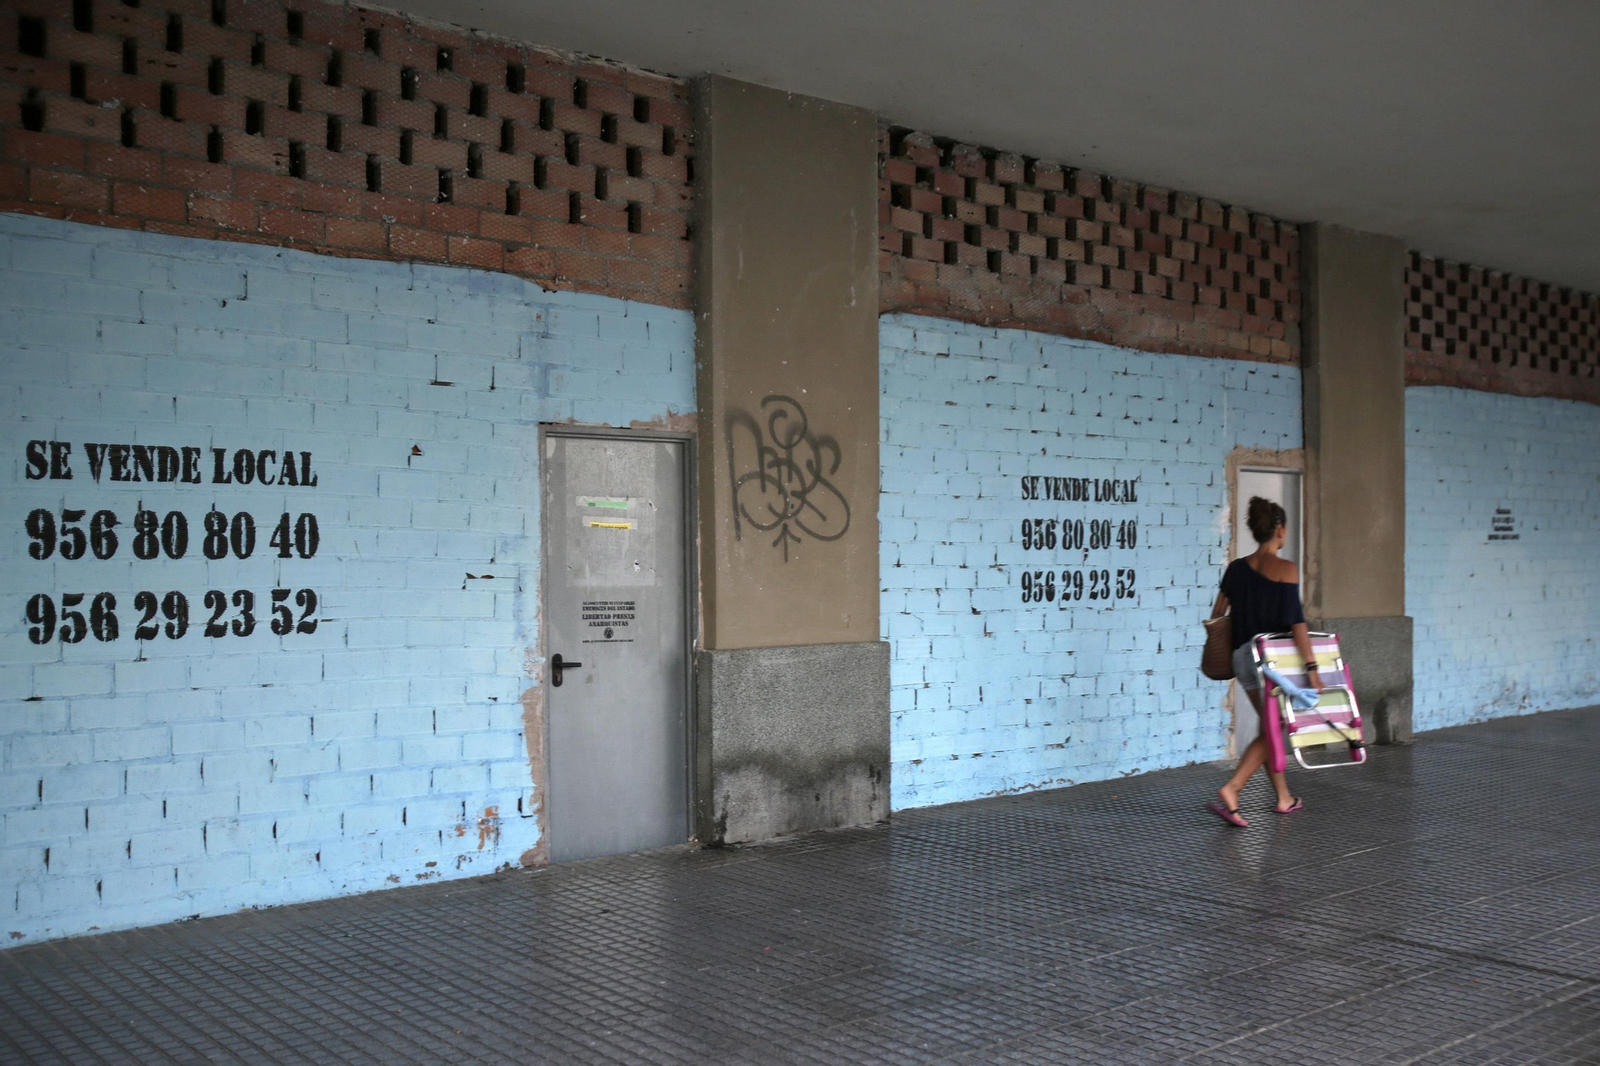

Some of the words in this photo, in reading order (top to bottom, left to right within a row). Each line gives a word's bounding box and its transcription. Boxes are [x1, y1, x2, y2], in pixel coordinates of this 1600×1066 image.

[25, 440, 73, 480] SE
[84, 443, 201, 484] VENDE
[212, 448, 318, 486] LOCAL
[1021, 476, 1040, 500] SE
[1043, 476, 1090, 501] VENDE
[1094, 478, 1138, 502] LOCAL
[25, 508, 118, 560] 956
[132, 510, 189, 560] 80
[203, 511, 256, 560] 80
[269, 512, 320, 559] 40
[1021, 518, 1057, 550] 956
[1062, 518, 1084, 550] 80
[1089, 519, 1111, 550] 80
[1116, 519, 1137, 550] 40
[1021, 570, 1056, 603] 956
[1061, 570, 1084, 601] 29
[1089, 569, 1110, 600] 23
[1116, 569, 1136, 599] 52
[25, 592, 119, 645] 956
[133, 590, 189, 641] 29
[203, 590, 255, 638] 23
[270, 588, 318, 636] 52
